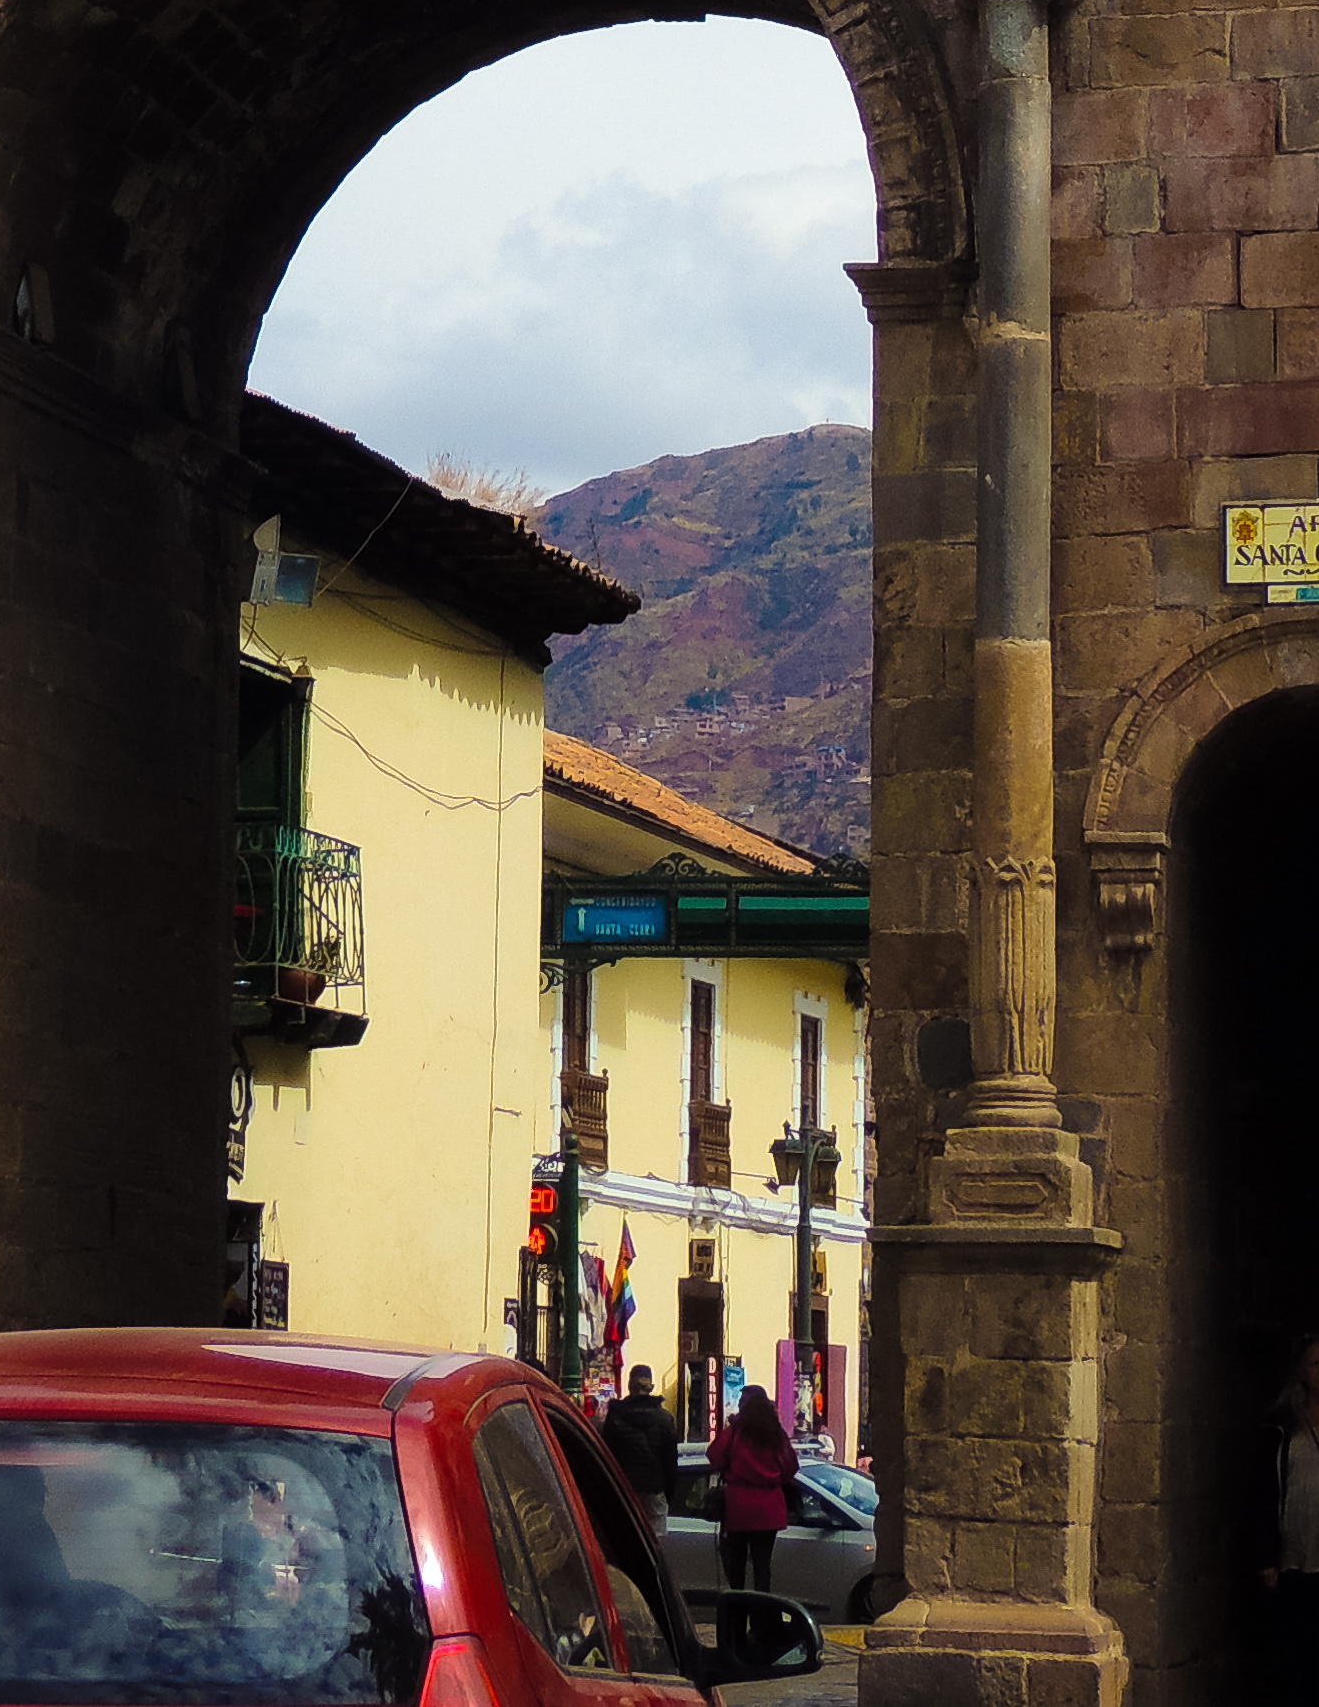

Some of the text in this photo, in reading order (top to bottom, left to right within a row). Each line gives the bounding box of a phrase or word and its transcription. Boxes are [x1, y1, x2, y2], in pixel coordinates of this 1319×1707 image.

[1233, 543, 1307, 566] SANTA
[595, 923, 656, 936] SANTA CLARA
